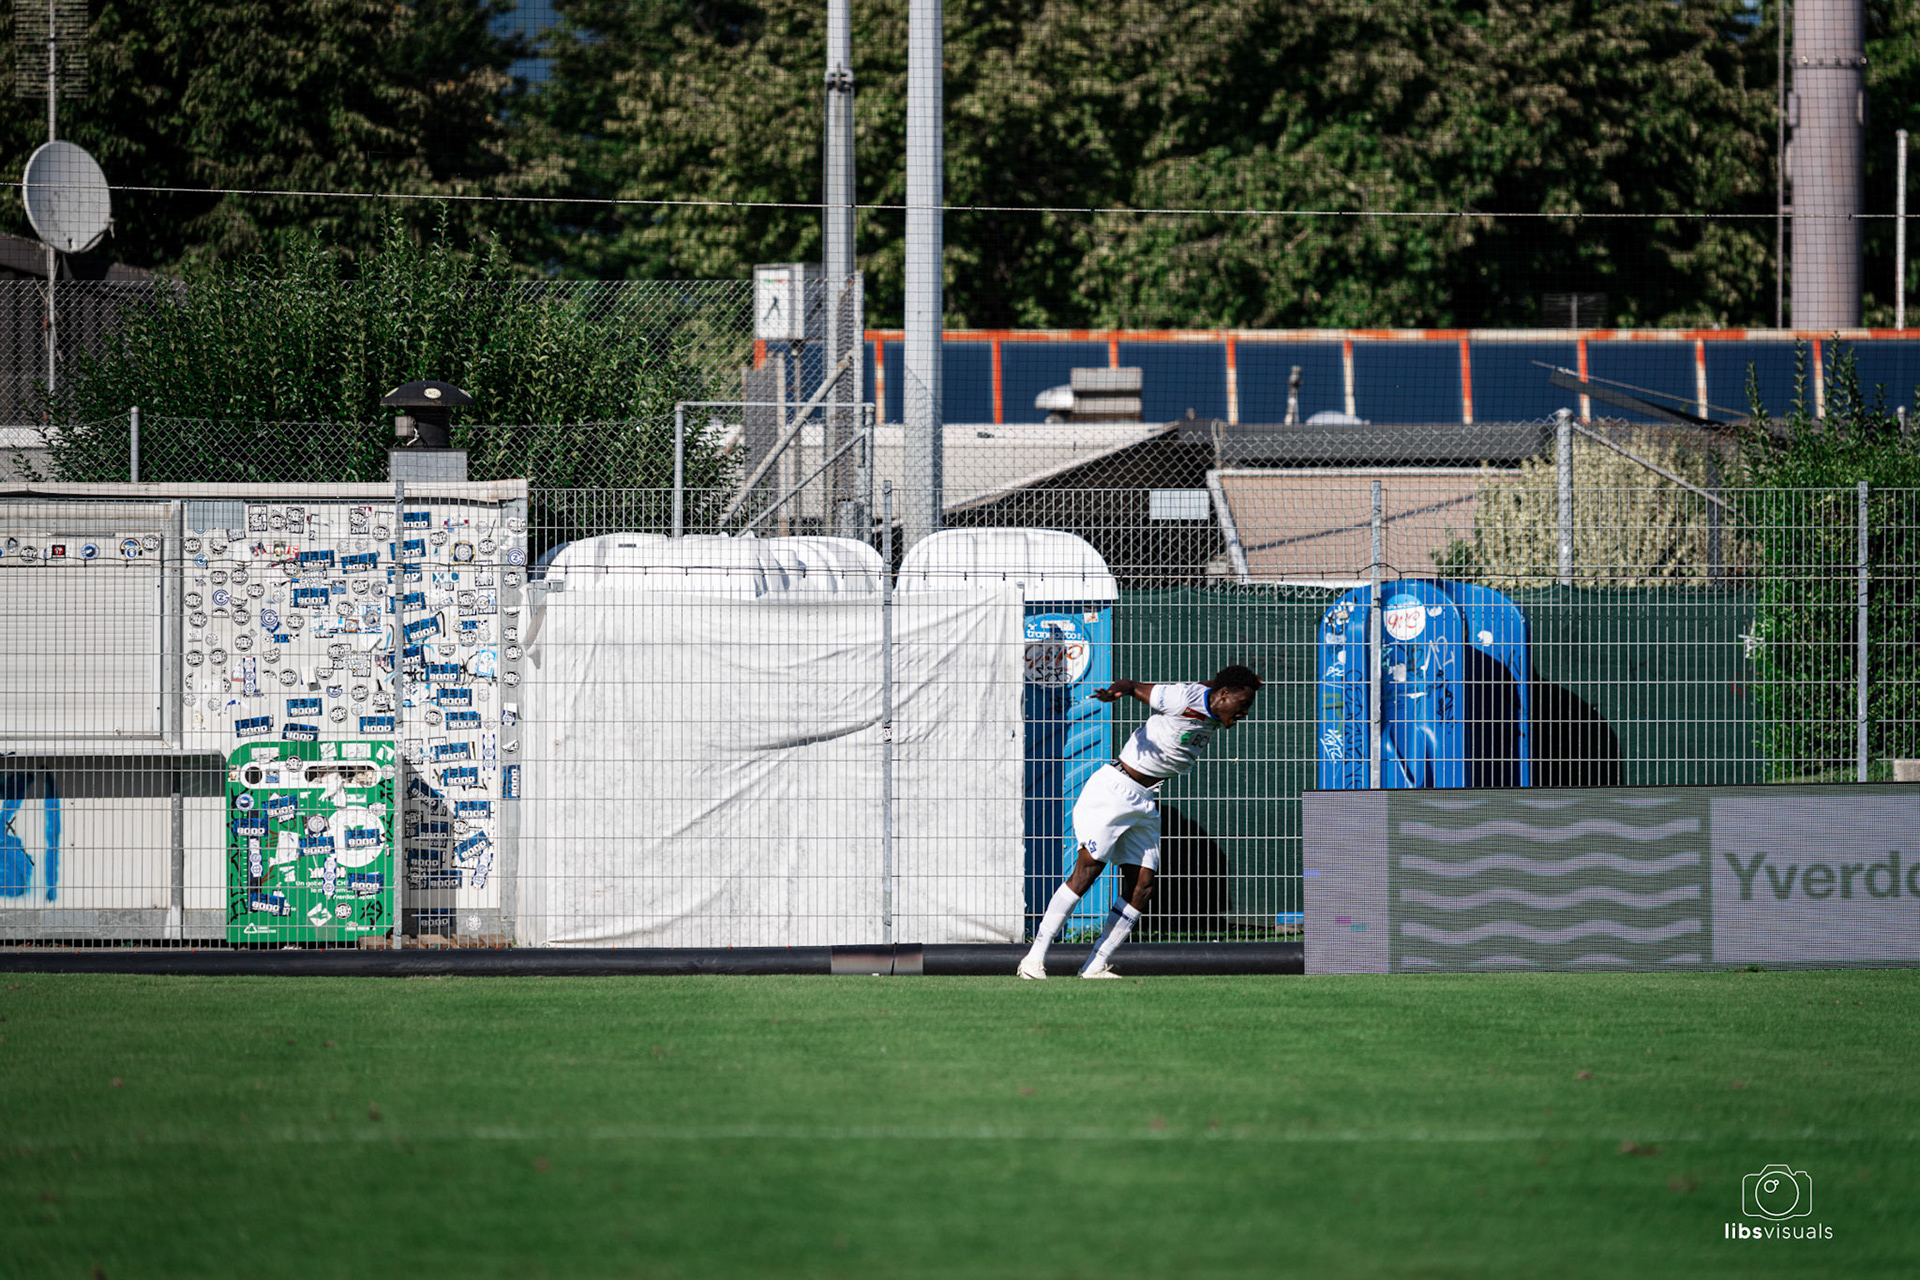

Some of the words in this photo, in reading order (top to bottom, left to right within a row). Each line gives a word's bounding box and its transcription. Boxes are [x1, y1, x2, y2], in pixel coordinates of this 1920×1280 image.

[409, 626, 437, 640] 8000
[241, 725, 268, 736] 8000
[440, 752, 467, 761] 8000
[447, 776, 475, 784] 8000
[237, 828, 265, 836] 8000
[349, 838, 376, 846] 8000
[461, 841, 487, 859] 8000
[411, 859, 439, 867] 8000
[252, 901, 280, 912] 8000
[421, 919, 448, 927] 8000
